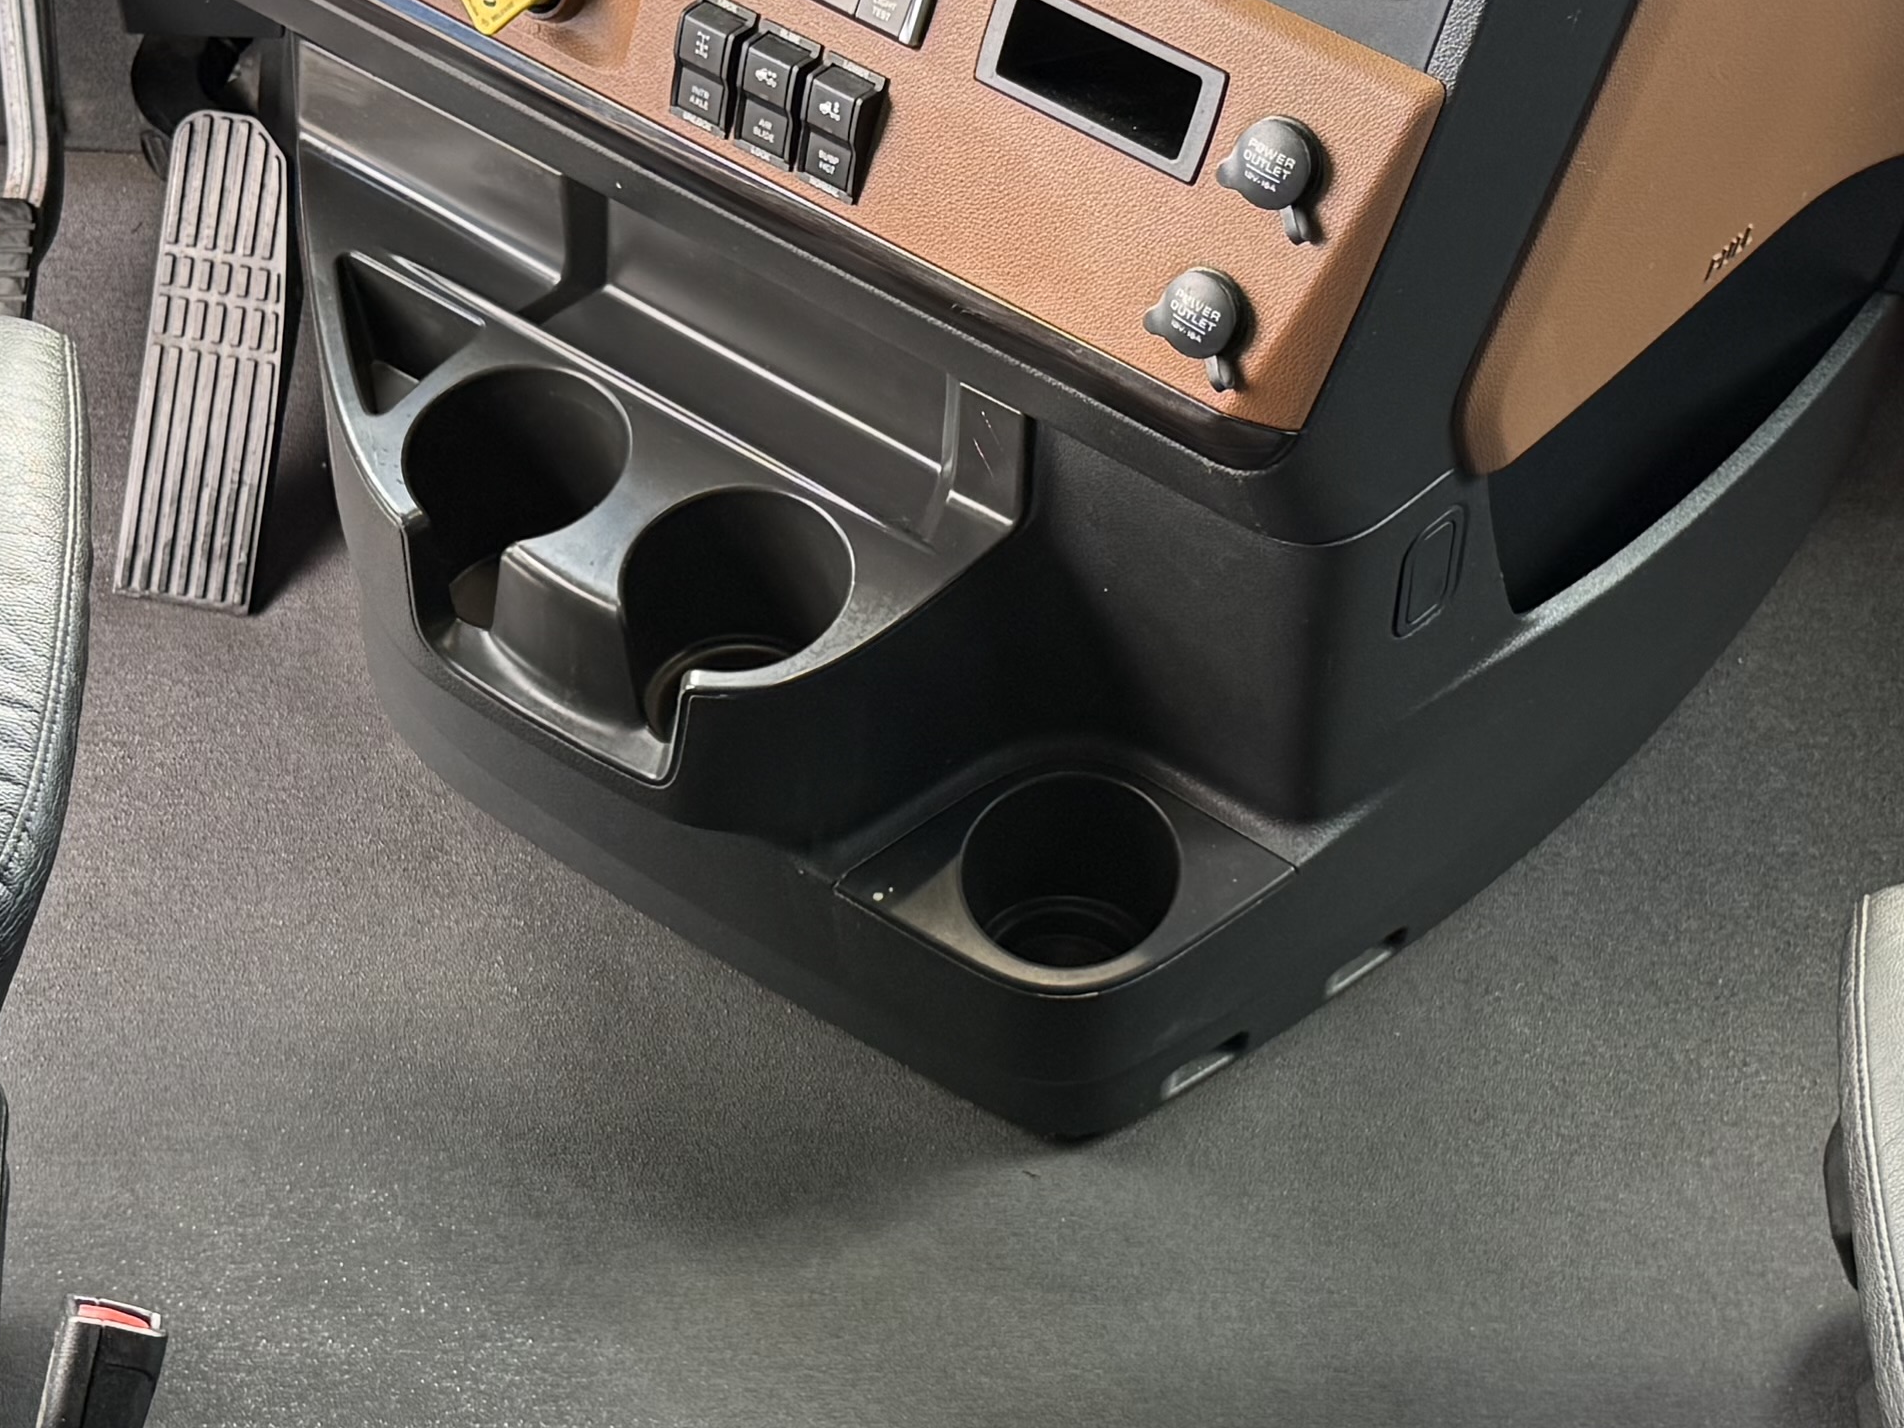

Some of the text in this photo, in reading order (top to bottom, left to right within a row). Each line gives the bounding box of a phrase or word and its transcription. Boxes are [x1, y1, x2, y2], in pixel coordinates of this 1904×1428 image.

[871, 6, 892, 22] TEST
[689, 94, 709, 111] AXLE
[758, 118, 773, 130] AIR
[1243, 149, 1291, 180] OUTLET
[1247, 136, 1296, 170] POWER
[1170, 298, 1217, 332] OUTLET
[1174, 287, 1222, 322] POWER
